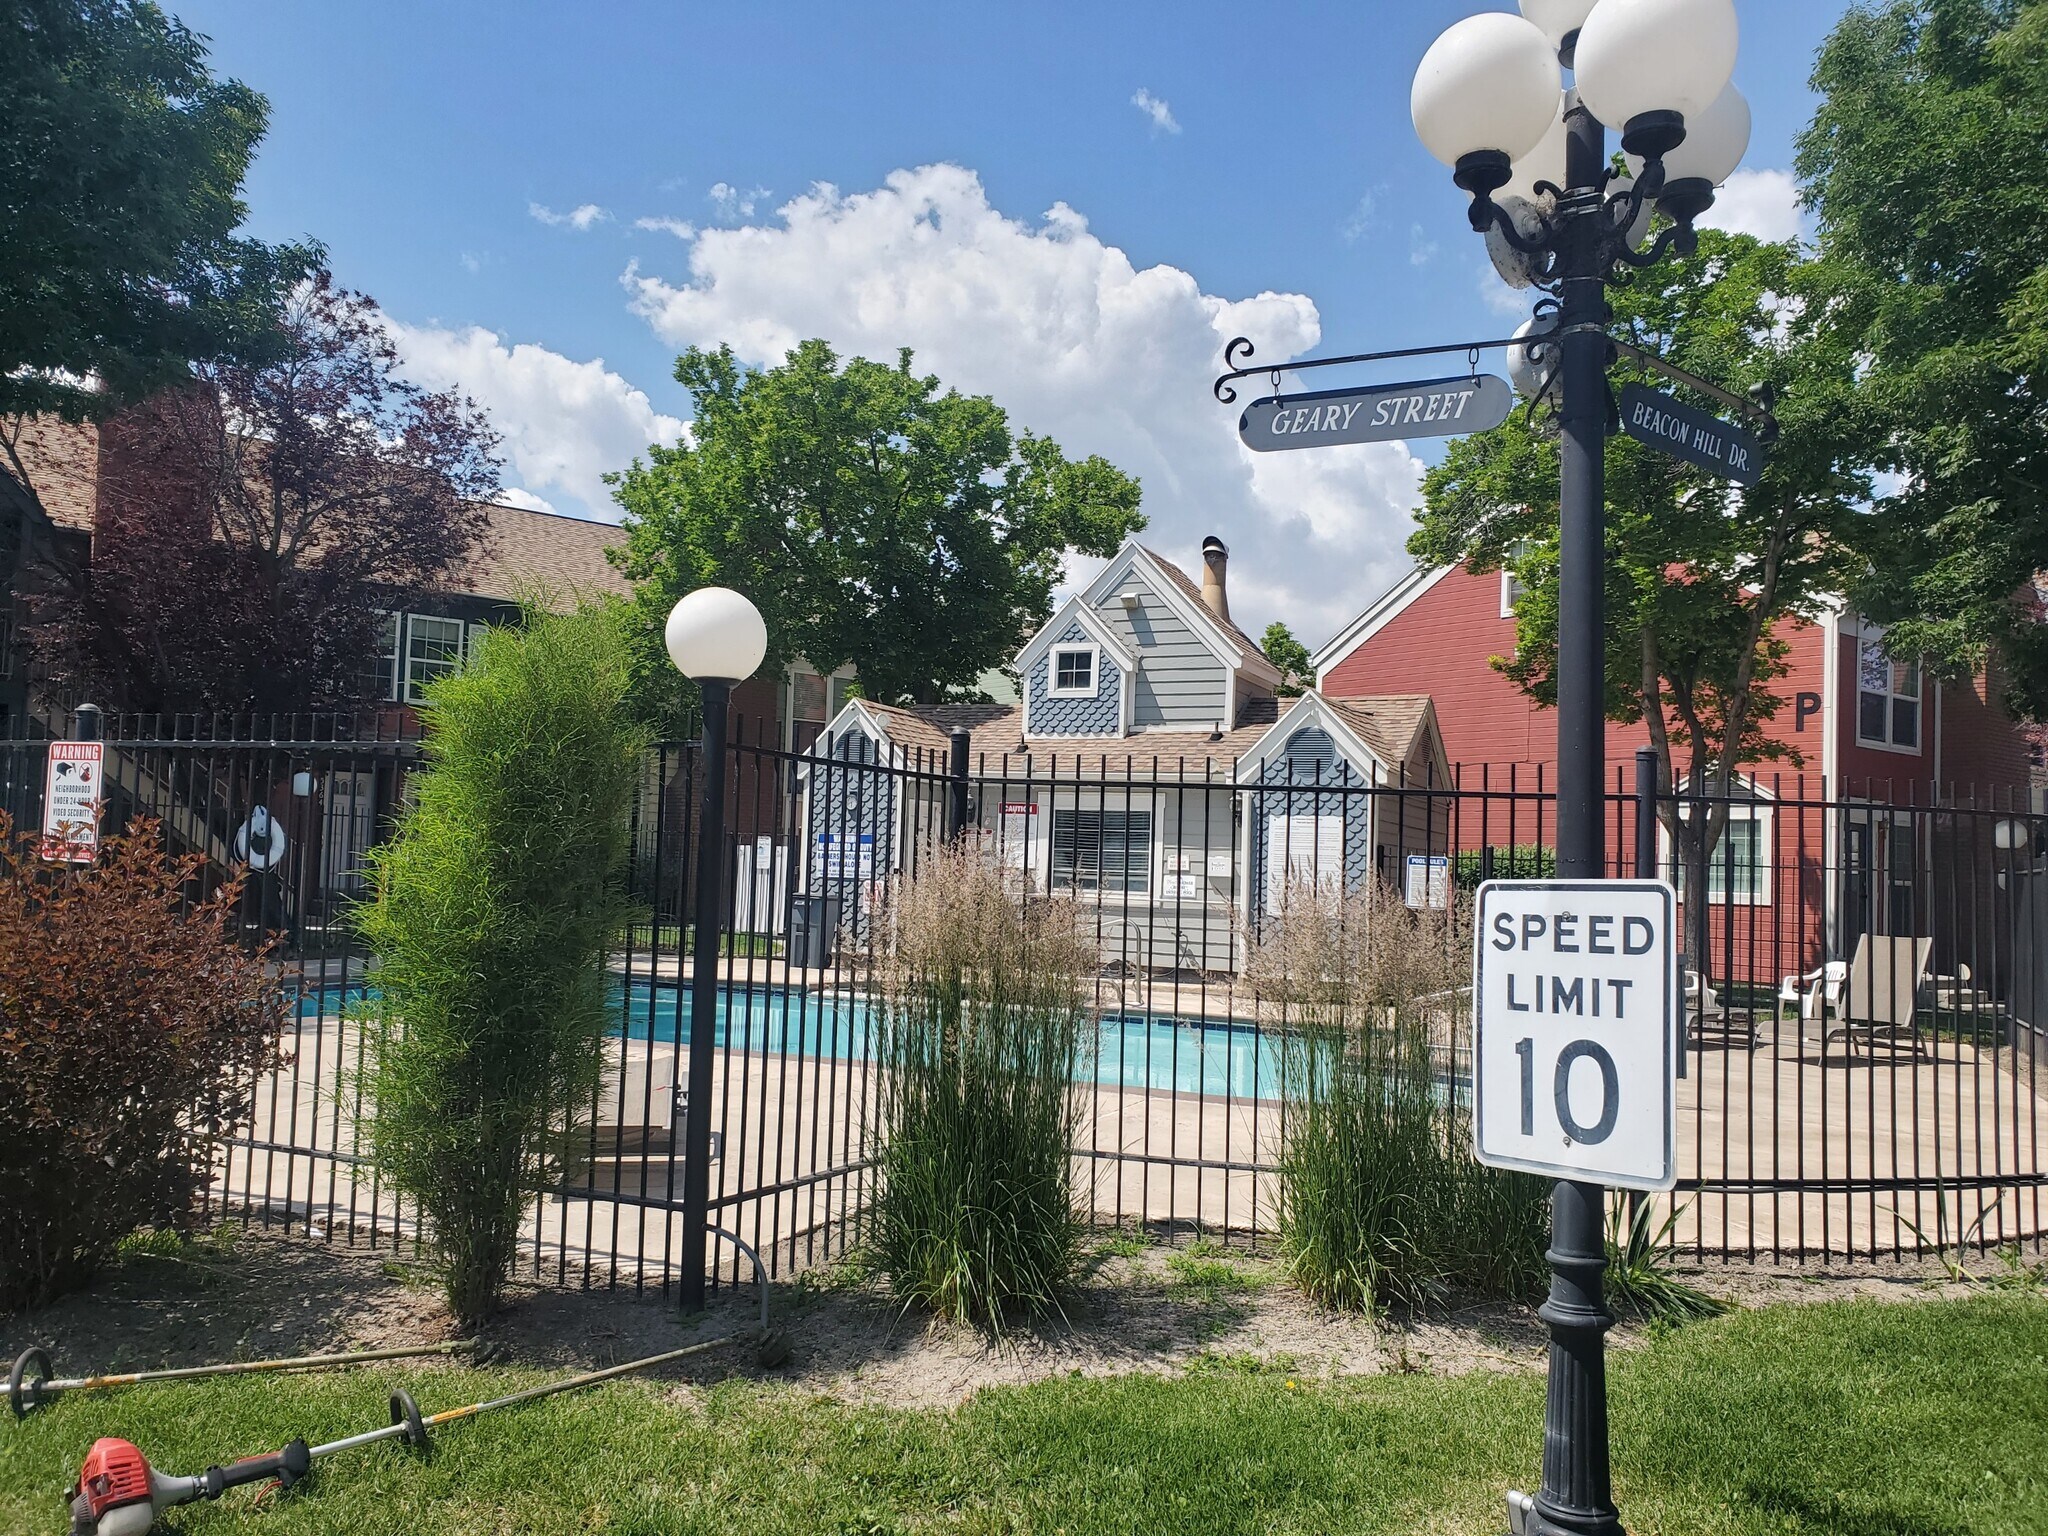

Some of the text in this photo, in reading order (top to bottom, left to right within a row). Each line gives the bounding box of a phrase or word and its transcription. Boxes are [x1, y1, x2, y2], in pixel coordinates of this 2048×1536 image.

[1271, 391, 1474, 435] GEARY STREET
[1632, 401, 1750, 472] BEACON HILL DR.
[1796, 692, 1822, 732] P
[53, 745, 99, 759] WARNING
[53, 796, 69, 805] UNDER
[55, 785, 91, 794] NEIGHBORHOOD
[53, 808, 91, 818] VIDEO SECURITY
[1492, 912, 1654, 955] SPEED
[1507, 973, 1633, 1019] LIMIT
[1515, 1037, 1620, 1145] 10
